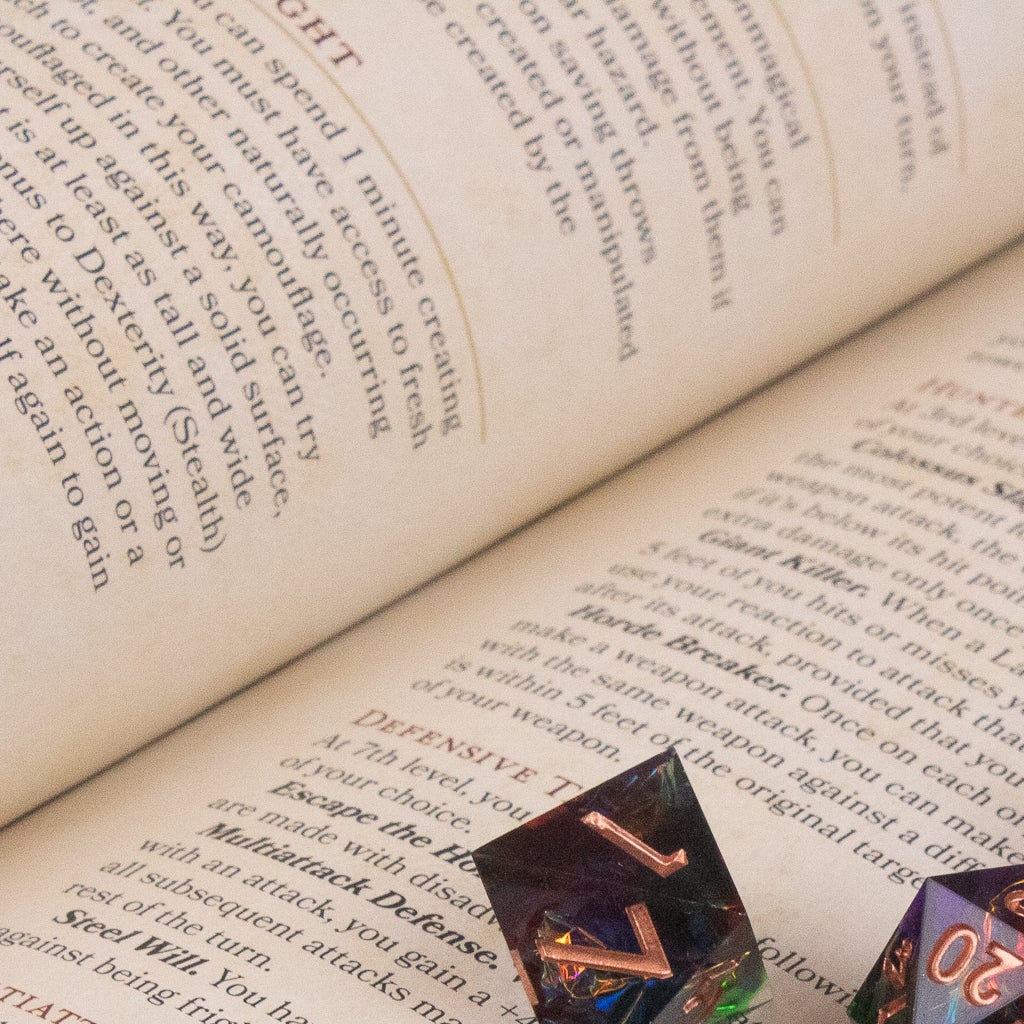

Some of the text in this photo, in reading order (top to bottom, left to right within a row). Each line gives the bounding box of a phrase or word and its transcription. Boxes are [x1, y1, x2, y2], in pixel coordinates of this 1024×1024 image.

[72, 244, 228, 555] Dexterity (Stealth)
[350, 708, 539, 782] DEFENSIVE
[207, 822, 371, 897] Multiattack
[52, 909, 142, 944] Steel
[211, 967, 267, 1008] You
[92, 956, 181, 1007] being
[925, 922, 1024, 1007] 20
